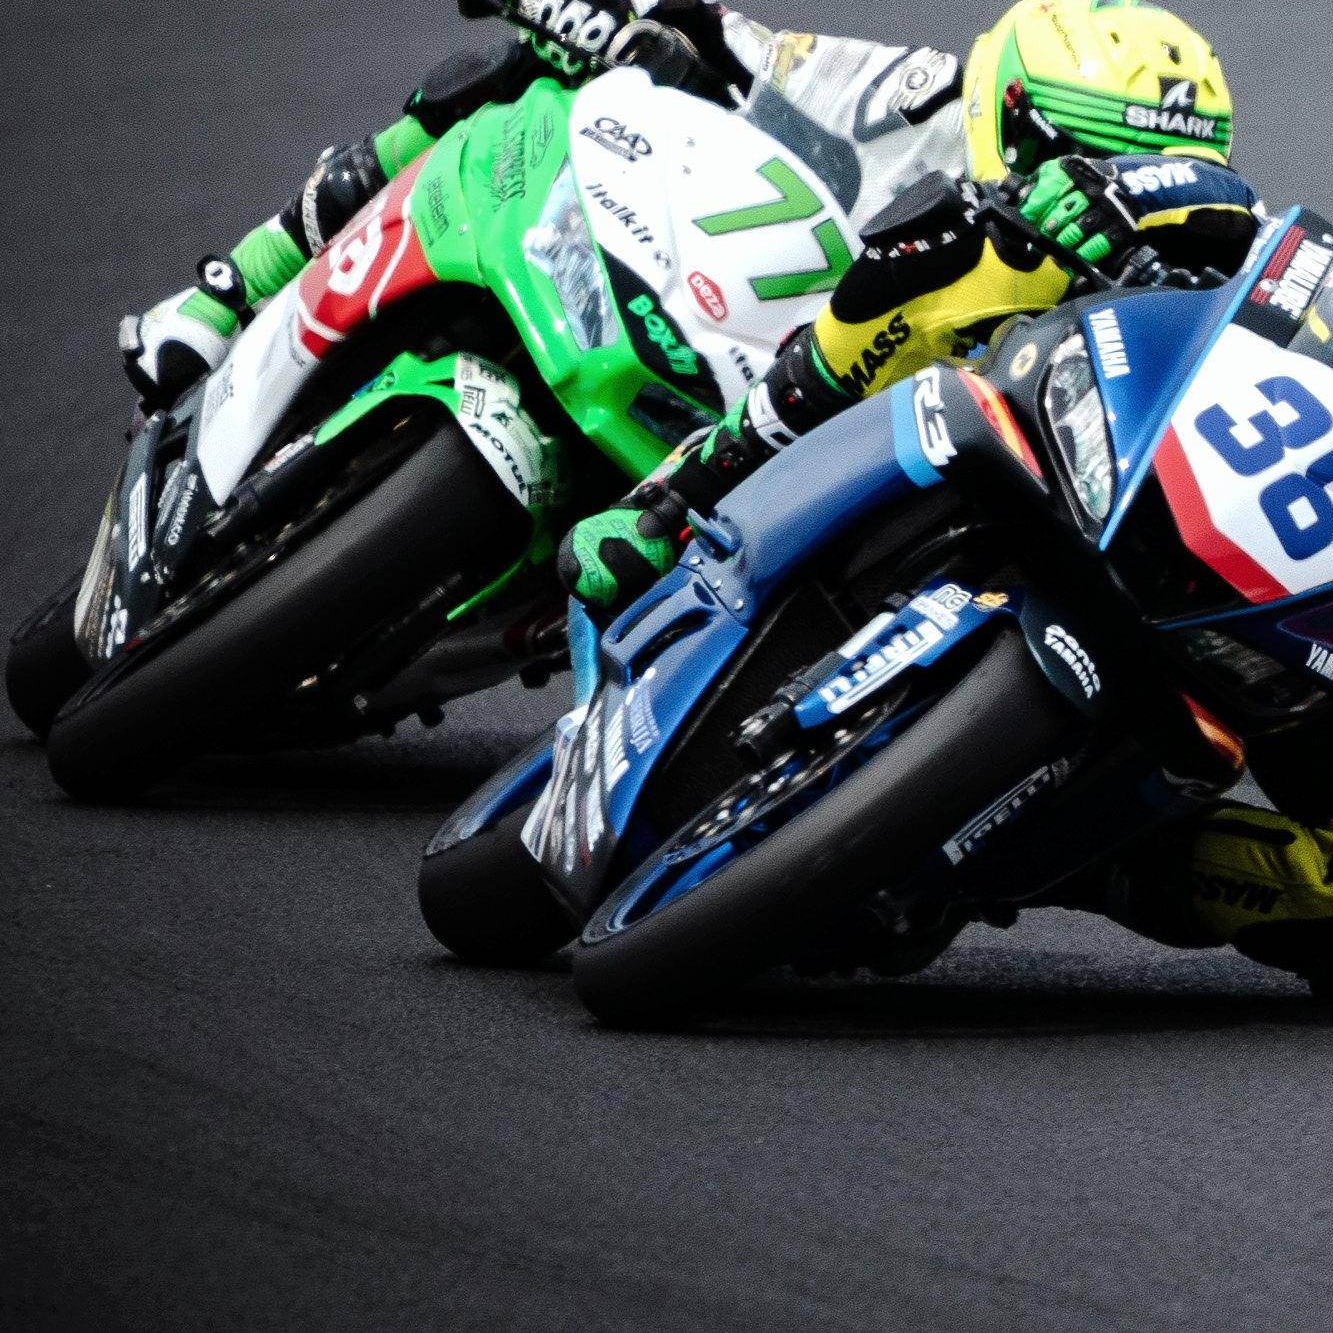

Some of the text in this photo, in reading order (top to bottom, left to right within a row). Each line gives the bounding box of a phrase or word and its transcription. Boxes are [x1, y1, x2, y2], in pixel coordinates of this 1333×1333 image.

[1124, 104, 1216, 139] SHARK
[691, 155, 855, 302] 77
[840, 310, 912, 400] MASS
[1089, 307, 1131, 379] YAMAHA
[468, 422, 527, 495] MOTUL
[1044, 633, 1094, 699] YAMAHA
